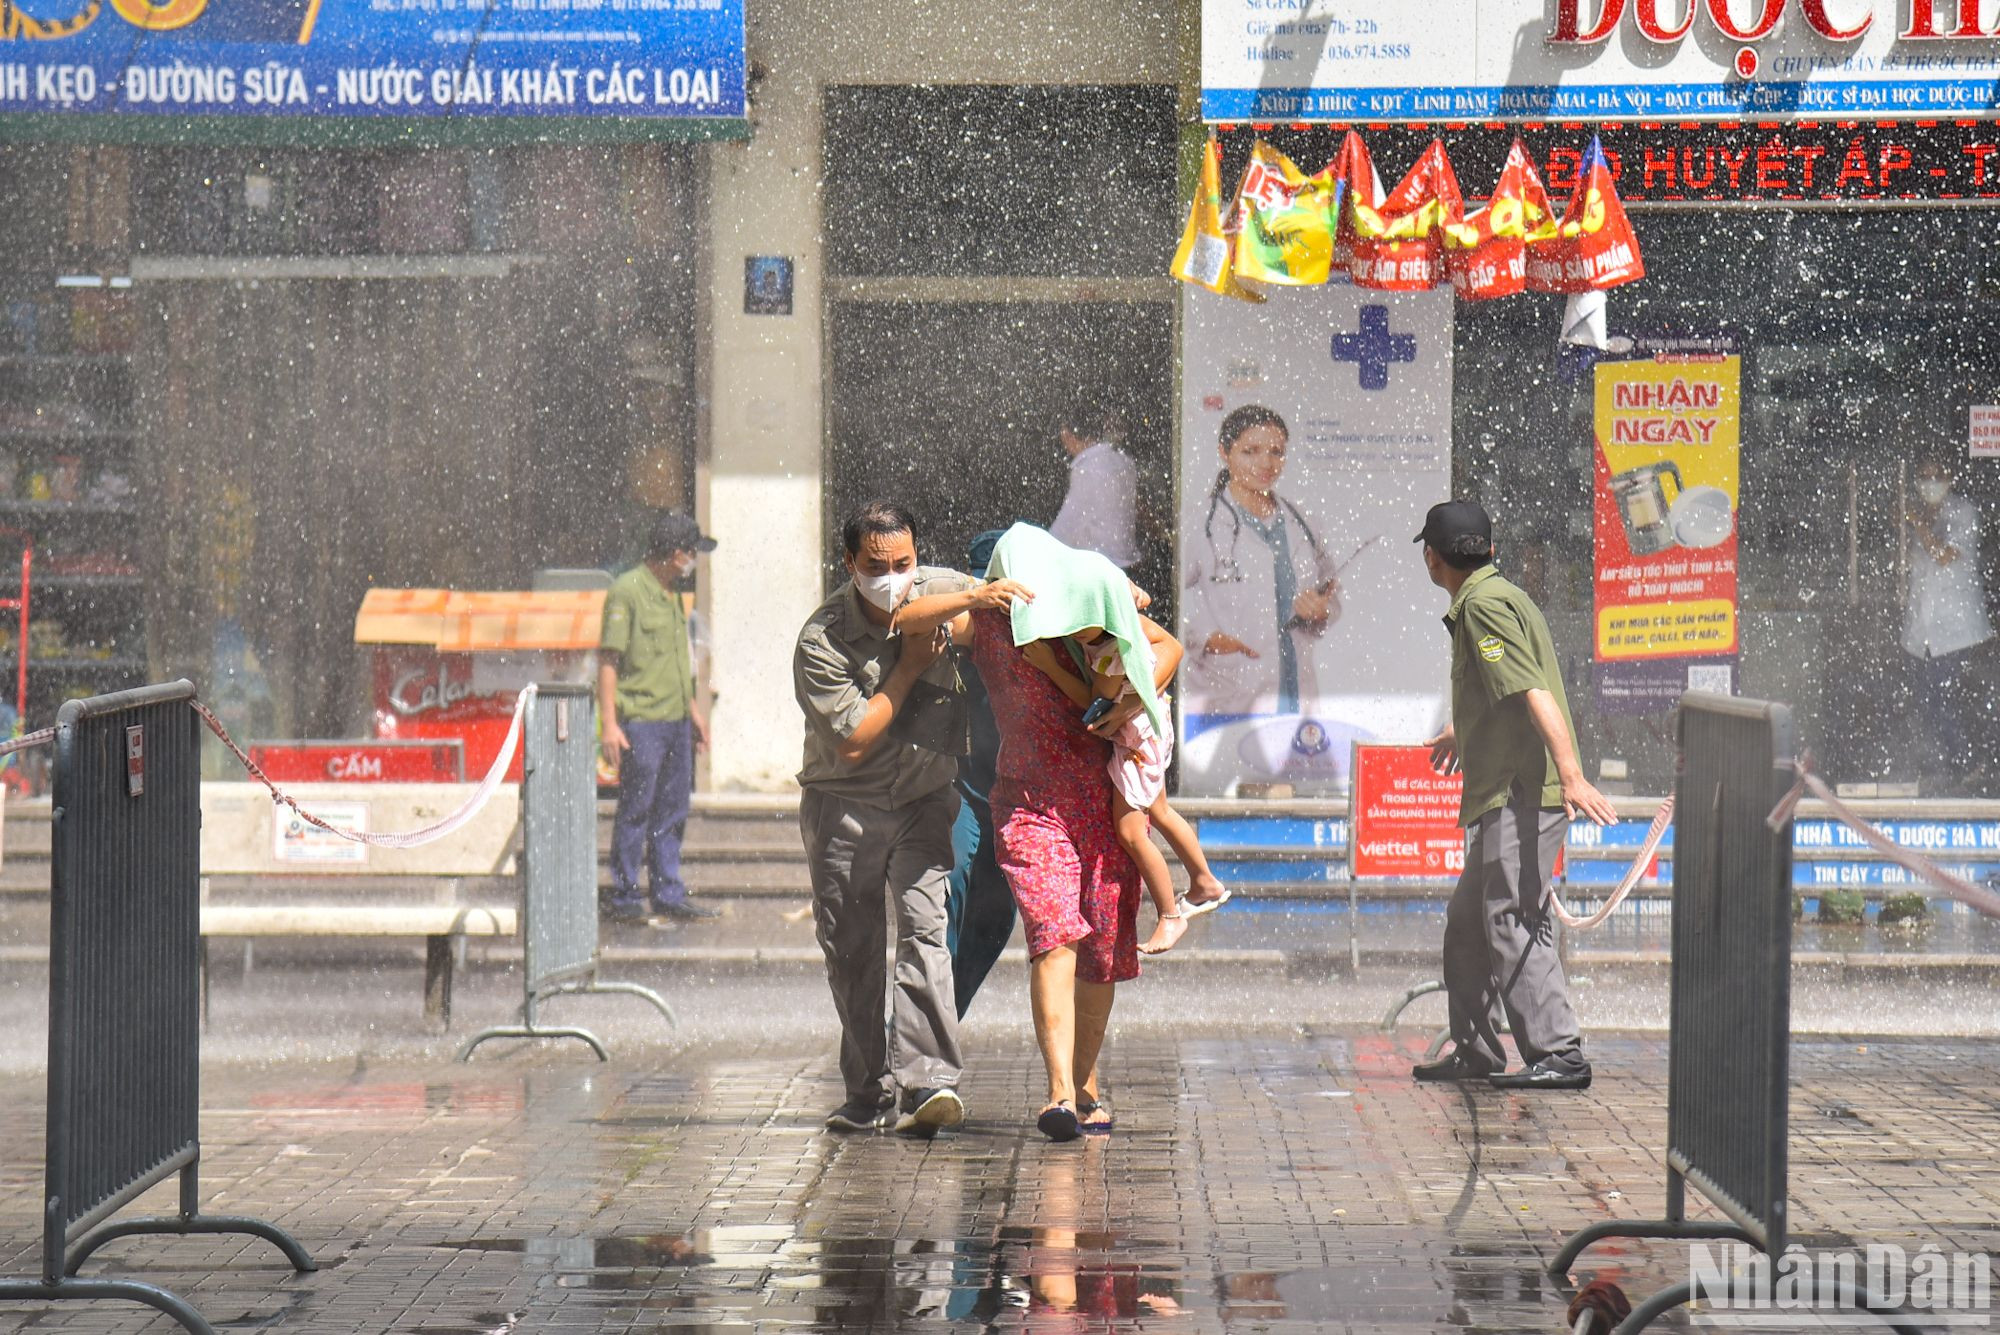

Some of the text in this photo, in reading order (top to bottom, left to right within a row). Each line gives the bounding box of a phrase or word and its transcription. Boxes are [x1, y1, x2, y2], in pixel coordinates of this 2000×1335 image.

[1246, 47, 1294, 61] Hotline
[1328, 44, 1411, 61] 036.974.5858
[1772, 52, 1840, 73] CHUYÊN
[35, 64, 97, 107] KẸO
[126, 59, 237, 104] ĐƯỜNG
[243, 60, 309, 104] SỮA
[337, 60, 424, 105] NƯỚC
[501, 60, 579, 105] KHÁT
[585, 61, 646, 105] CÁC
[654, 67, 720, 110] LOẠI
[1414, 94, 1450, 110] LINH
[1555, 92, 1588, 109] MAI
[1598, 88, 1621, 109] HÀ
[1625, 90, 1652, 113] NỘI
[1798, 88, 1839, 108] DƯỢC
[1892, 86, 1925, 108] HỌC
[1929, 85, 1969, 107] DƯỢC
[1974, 83, 1996, 103] HÀ
[1644, 135, 1826, 189] HUYẾT
[1835, 135, 1913, 188] ÁP
[1596, 239, 1634, 274] PHẨM
[1614, 378, 1719, 413] NHẬN
[1613, 417, 1720, 446] NGAY
[327, 751, 382, 779] CẤM
[1381, 793, 1416, 805] TRONG
[1417, 794, 1440, 804] KHU
[1360, 840, 1420, 857] viettel
[1900, 824, 1948, 850] DƯỢC
[1951, 823, 1977, 847] HÀ
[1814, 865, 1837, 883] TIN
